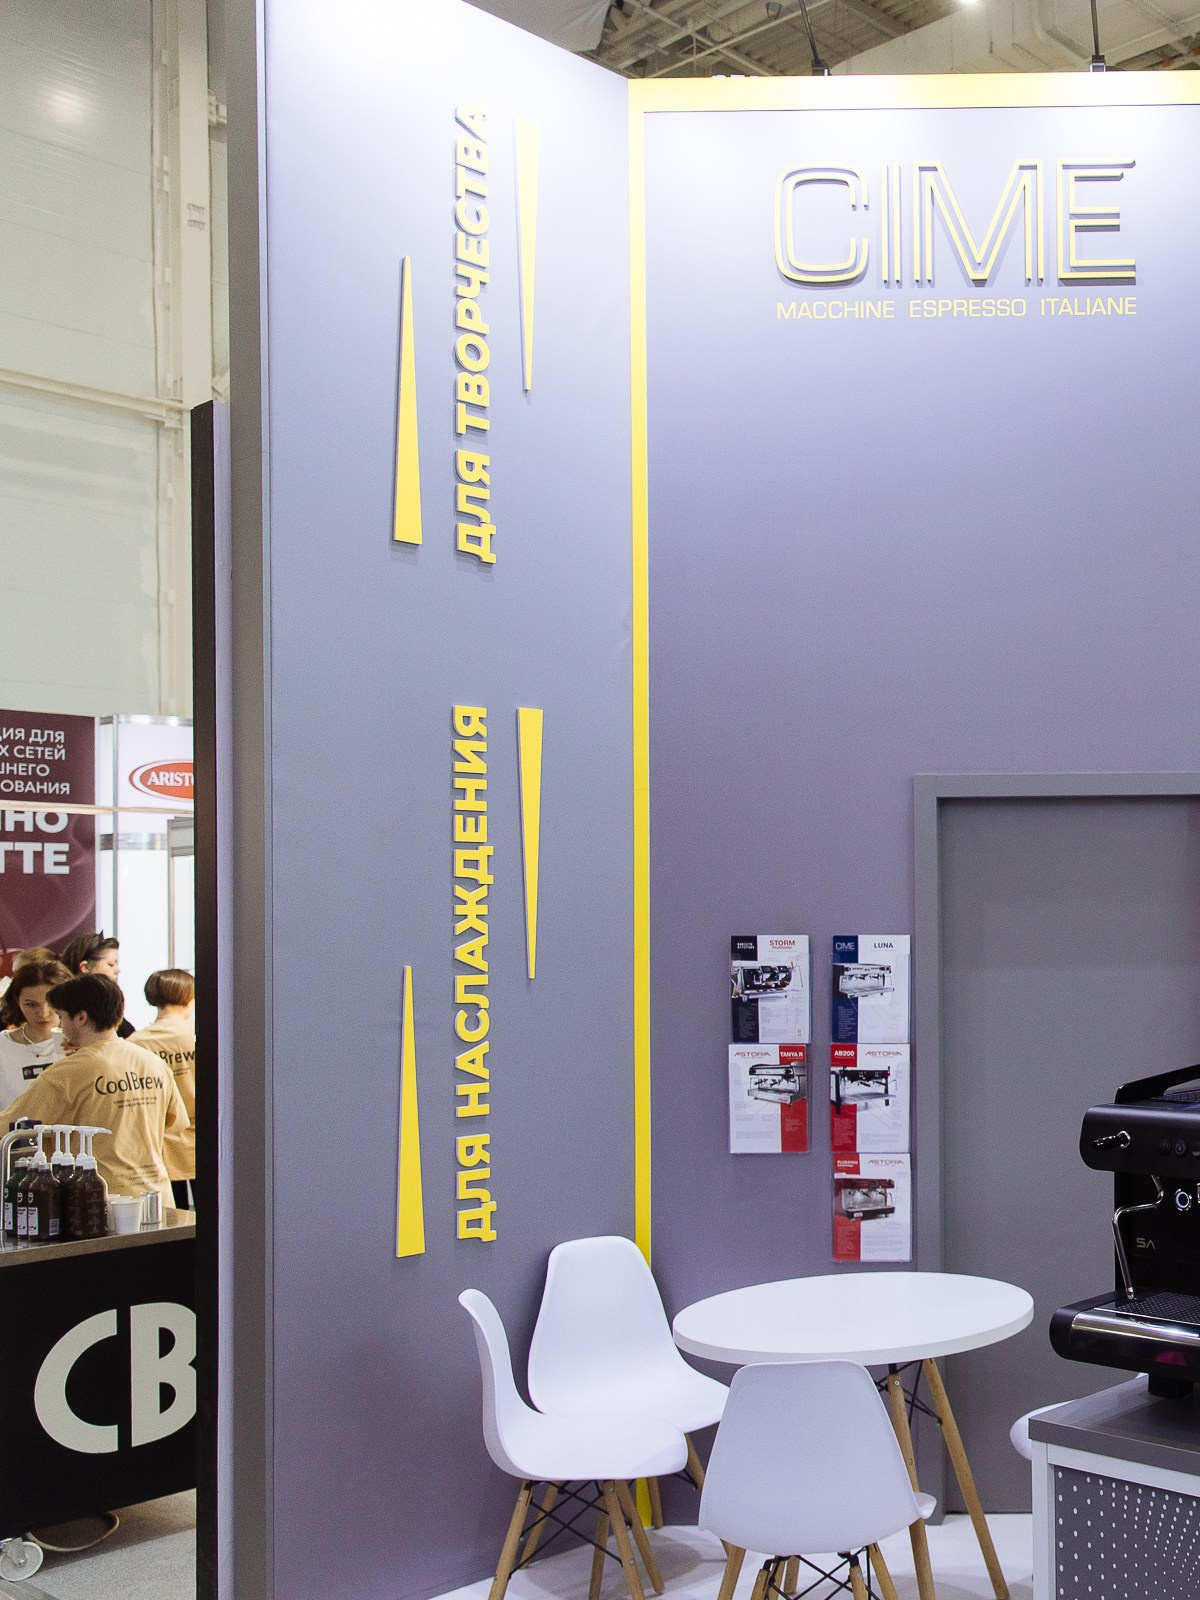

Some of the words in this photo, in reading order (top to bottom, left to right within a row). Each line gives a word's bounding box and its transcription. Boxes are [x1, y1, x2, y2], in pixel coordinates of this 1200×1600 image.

[774, 159, 1137, 285] CIME
[454, 103, 491, 436] ТВОРЧЕСТВА
[776, 300, 896, 320] MACCHINE
[909, 298, 1027, 319] ESPRESSO
[1040, 296, 1138, 317] ITALIANE
[454, 448, 498, 565] ДЛЯ
[0, 727, 25, 742] ИЯ
[29, 728, 65, 744] ДЛЯ
[13, 743, 66, 761] СЕТЕЙ
[0, 779, 70, 796] ОВАНИЯ
[147, 770, 194, 788] ARIST
[0, 810, 69, 834] НО
[452, 704, 494, 1119] НАСЛАЖДЕНИЯ
[835, 941, 855, 950] CIME
[156, 1050, 196, 1065] Brew
[95, 1071, 164, 1096] CoolBrew
[455, 1131, 498, 1243] ДЛЯ
[34, 1301, 197, 1454] CB
